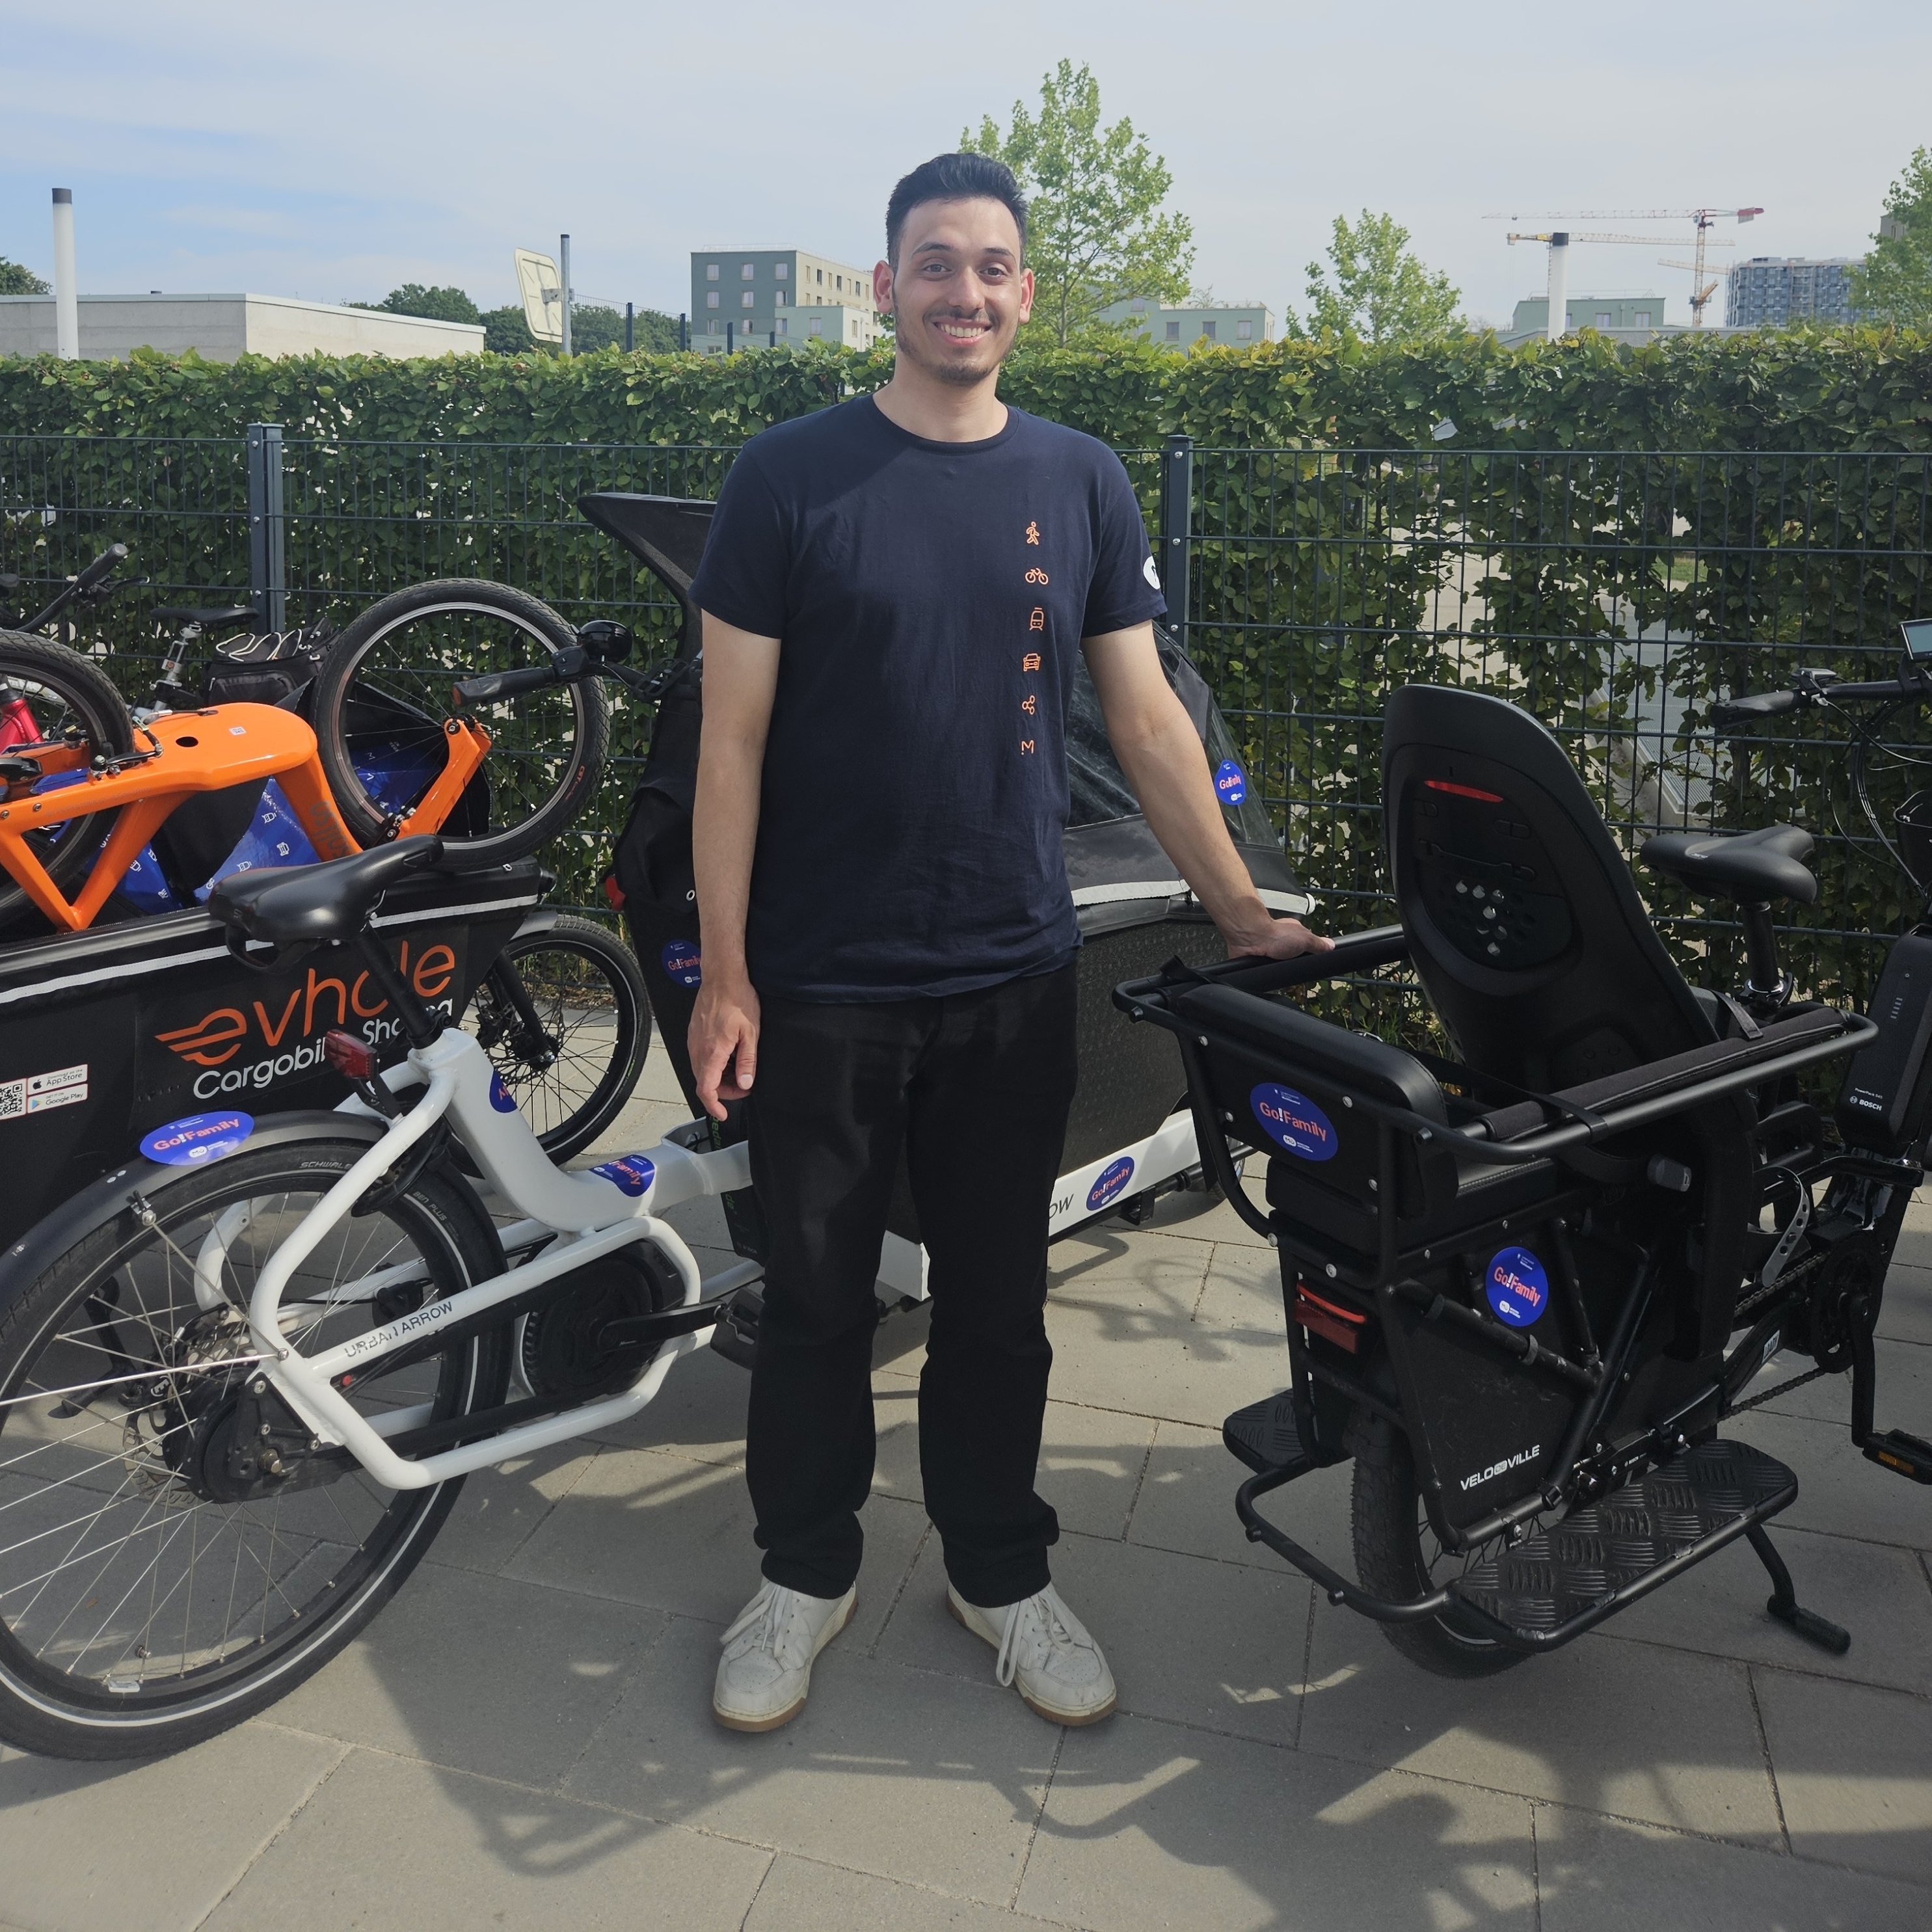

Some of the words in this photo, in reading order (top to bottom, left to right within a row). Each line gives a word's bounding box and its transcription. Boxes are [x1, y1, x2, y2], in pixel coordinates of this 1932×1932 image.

[63, 1073, 83, 1082] Store
[46, 1096, 70, 1105] Google
[70, 1093, 84, 1101] Play
[1858, 1099, 1883, 1111] BOSCH
[153, 1118, 240, 1151] Go!Family
[1259, 1102, 1326, 1142] Go!Family
[1092, 1166, 1130, 1201] Go!Family
[412, 1190, 430, 1203] BEN
[428, 1204, 448, 1221] PLUS
[1494, 1267, 1541, 1308] Go!Family
[401, 1300, 453, 1334] ARROW
